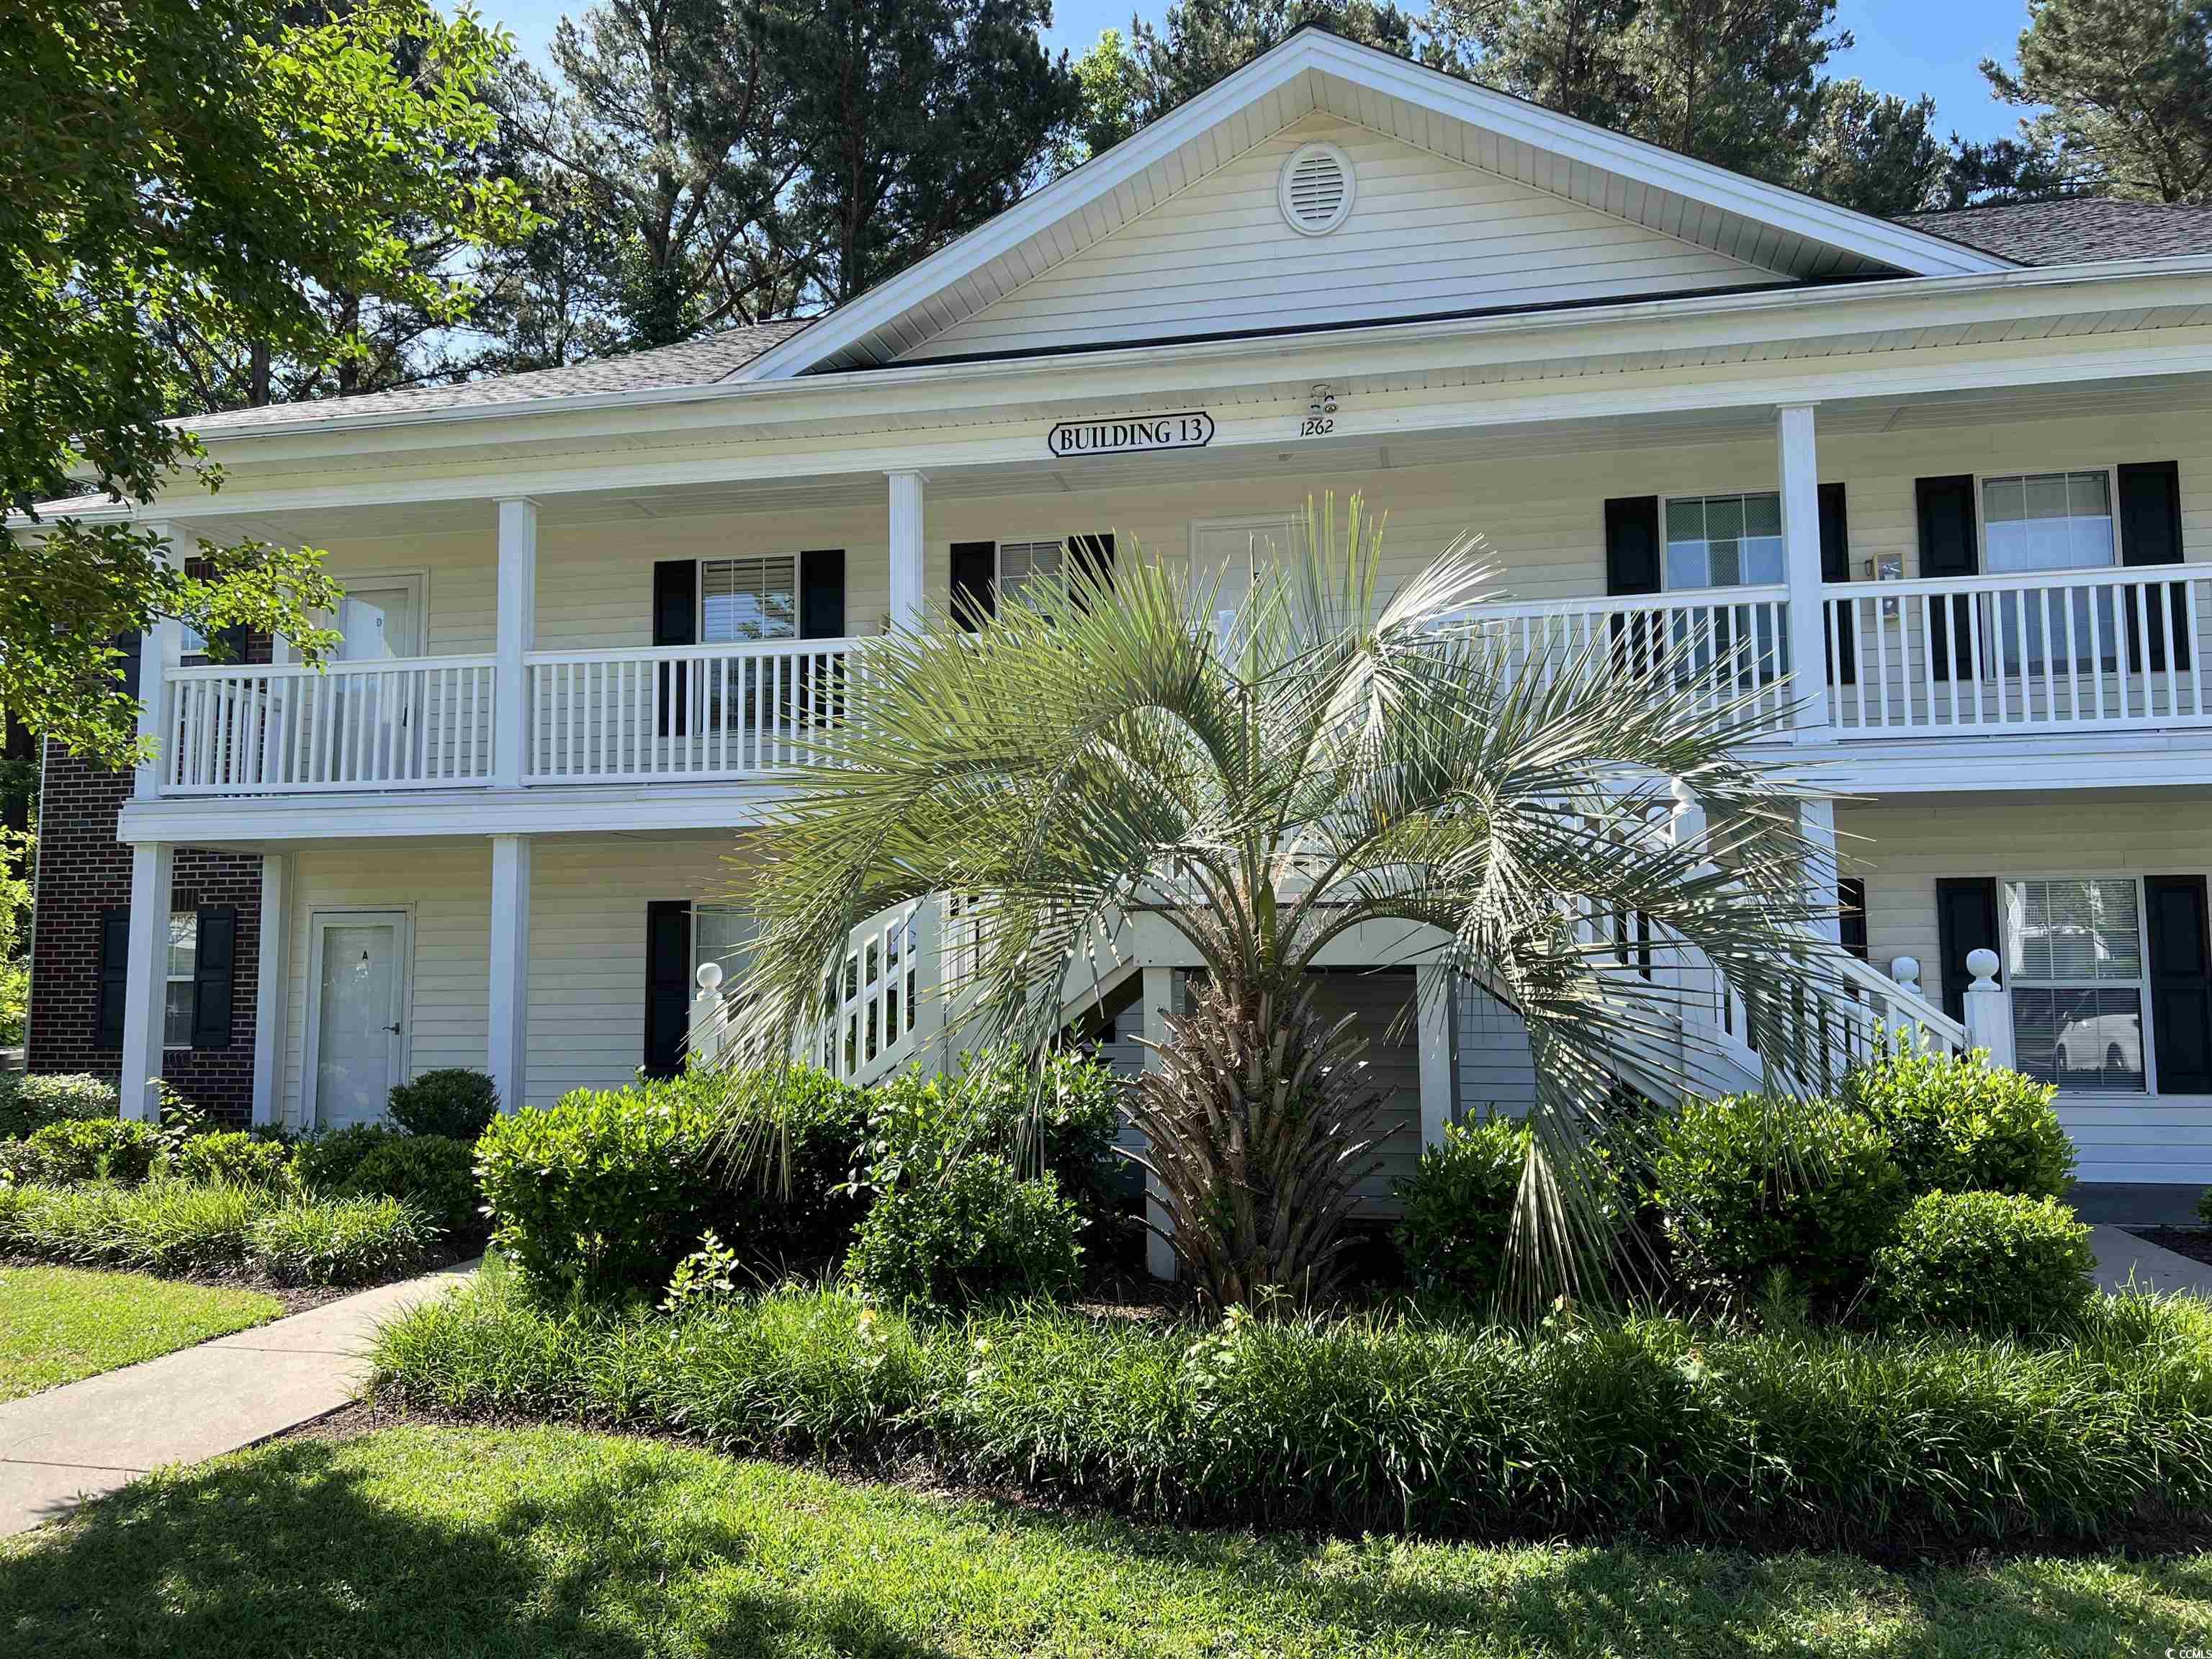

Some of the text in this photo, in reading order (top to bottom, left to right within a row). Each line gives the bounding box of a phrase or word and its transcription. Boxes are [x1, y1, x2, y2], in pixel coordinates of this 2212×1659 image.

[1059, 418, 1203, 451] BUILDING 13
[1300, 419, 1334, 437] 1262
[362, 950, 368, 960] A
